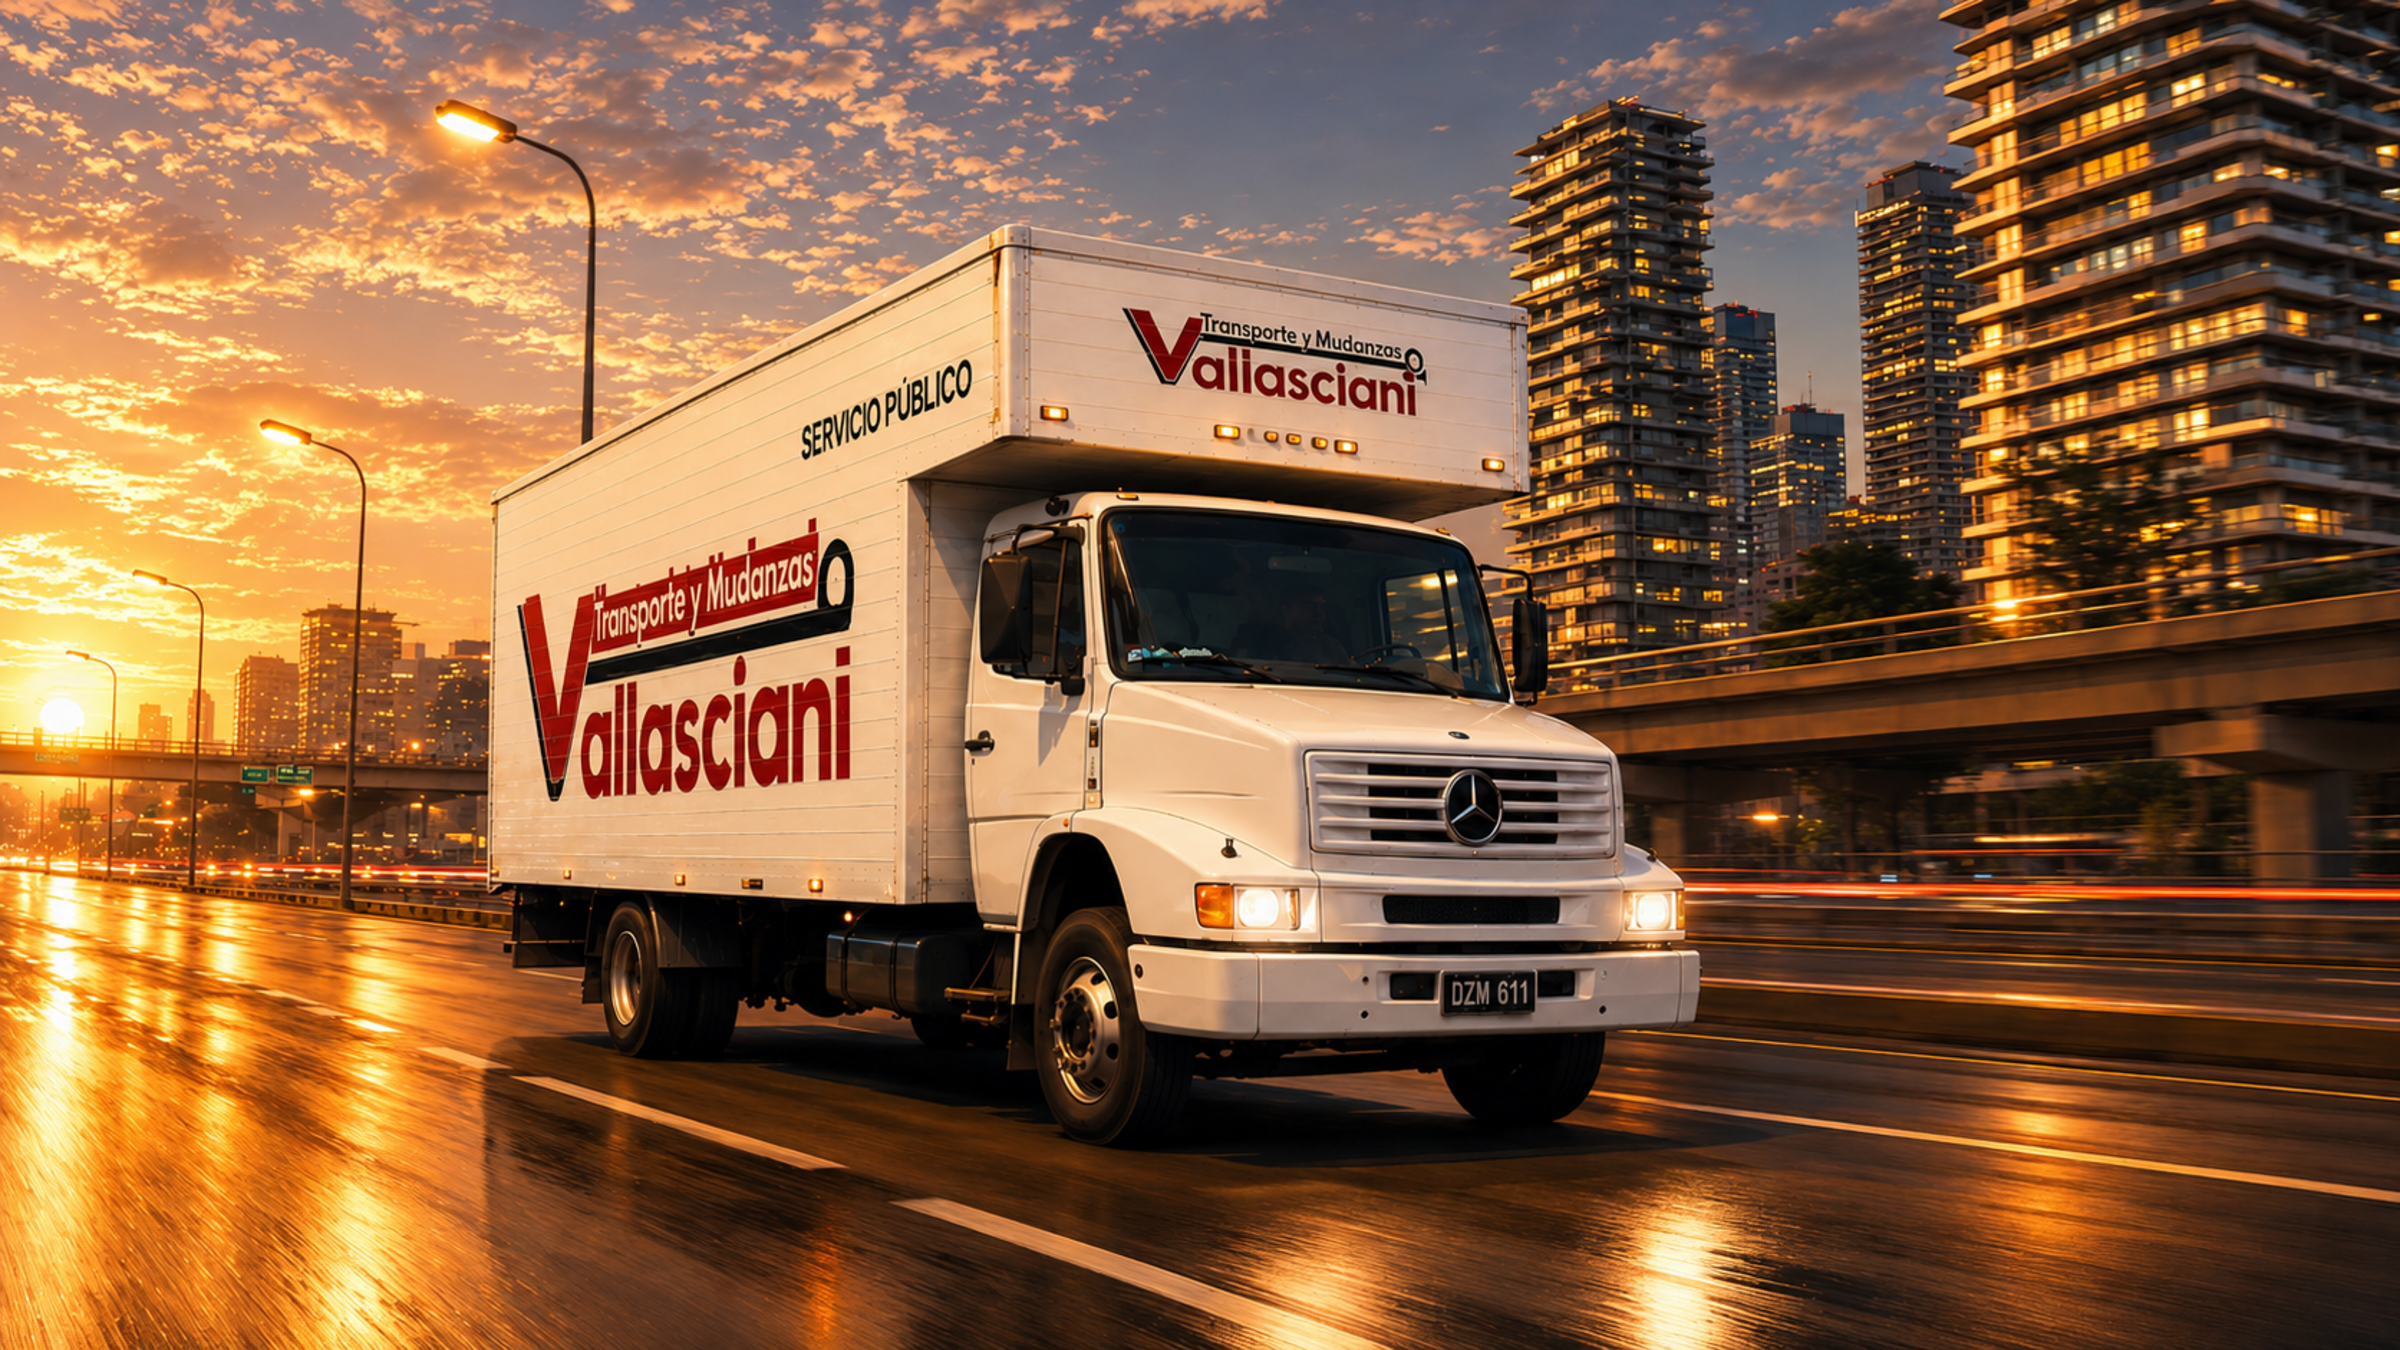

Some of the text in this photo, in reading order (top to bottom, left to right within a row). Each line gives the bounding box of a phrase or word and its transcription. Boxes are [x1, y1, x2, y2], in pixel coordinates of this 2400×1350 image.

[1200, 312, 1402, 360] Transporte y Mudanzas
[801, 359, 972, 460] SERVICIO PÚBLICO
[594, 551, 814, 649] Transporte y Mudanzas
[517, 593, 851, 802] Vallasciani
[1452, 980, 1528, 1006] DZM 611
